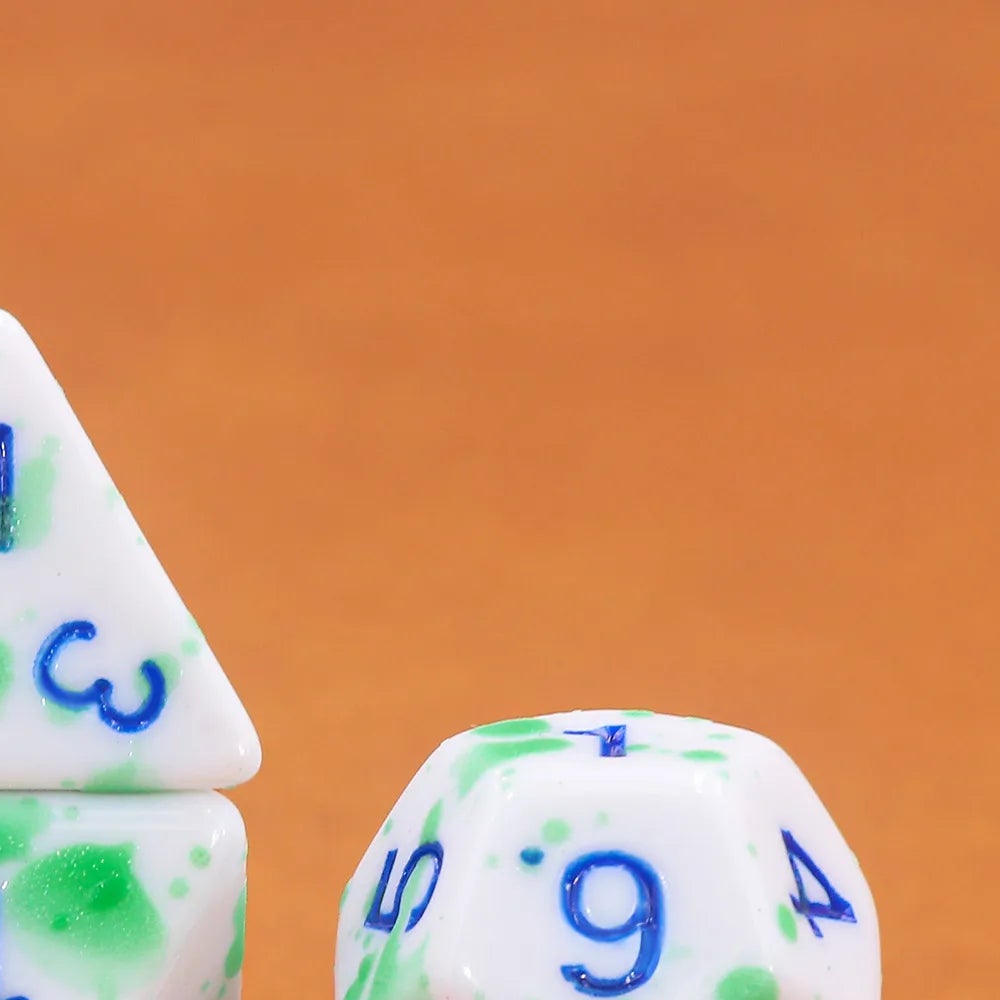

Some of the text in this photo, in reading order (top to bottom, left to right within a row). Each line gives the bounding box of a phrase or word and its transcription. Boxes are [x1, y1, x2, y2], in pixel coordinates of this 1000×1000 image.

[32, 619, 167, 734] 3
[363, 840, 445, 933] 5
[781, 828, 858, 938] 4
